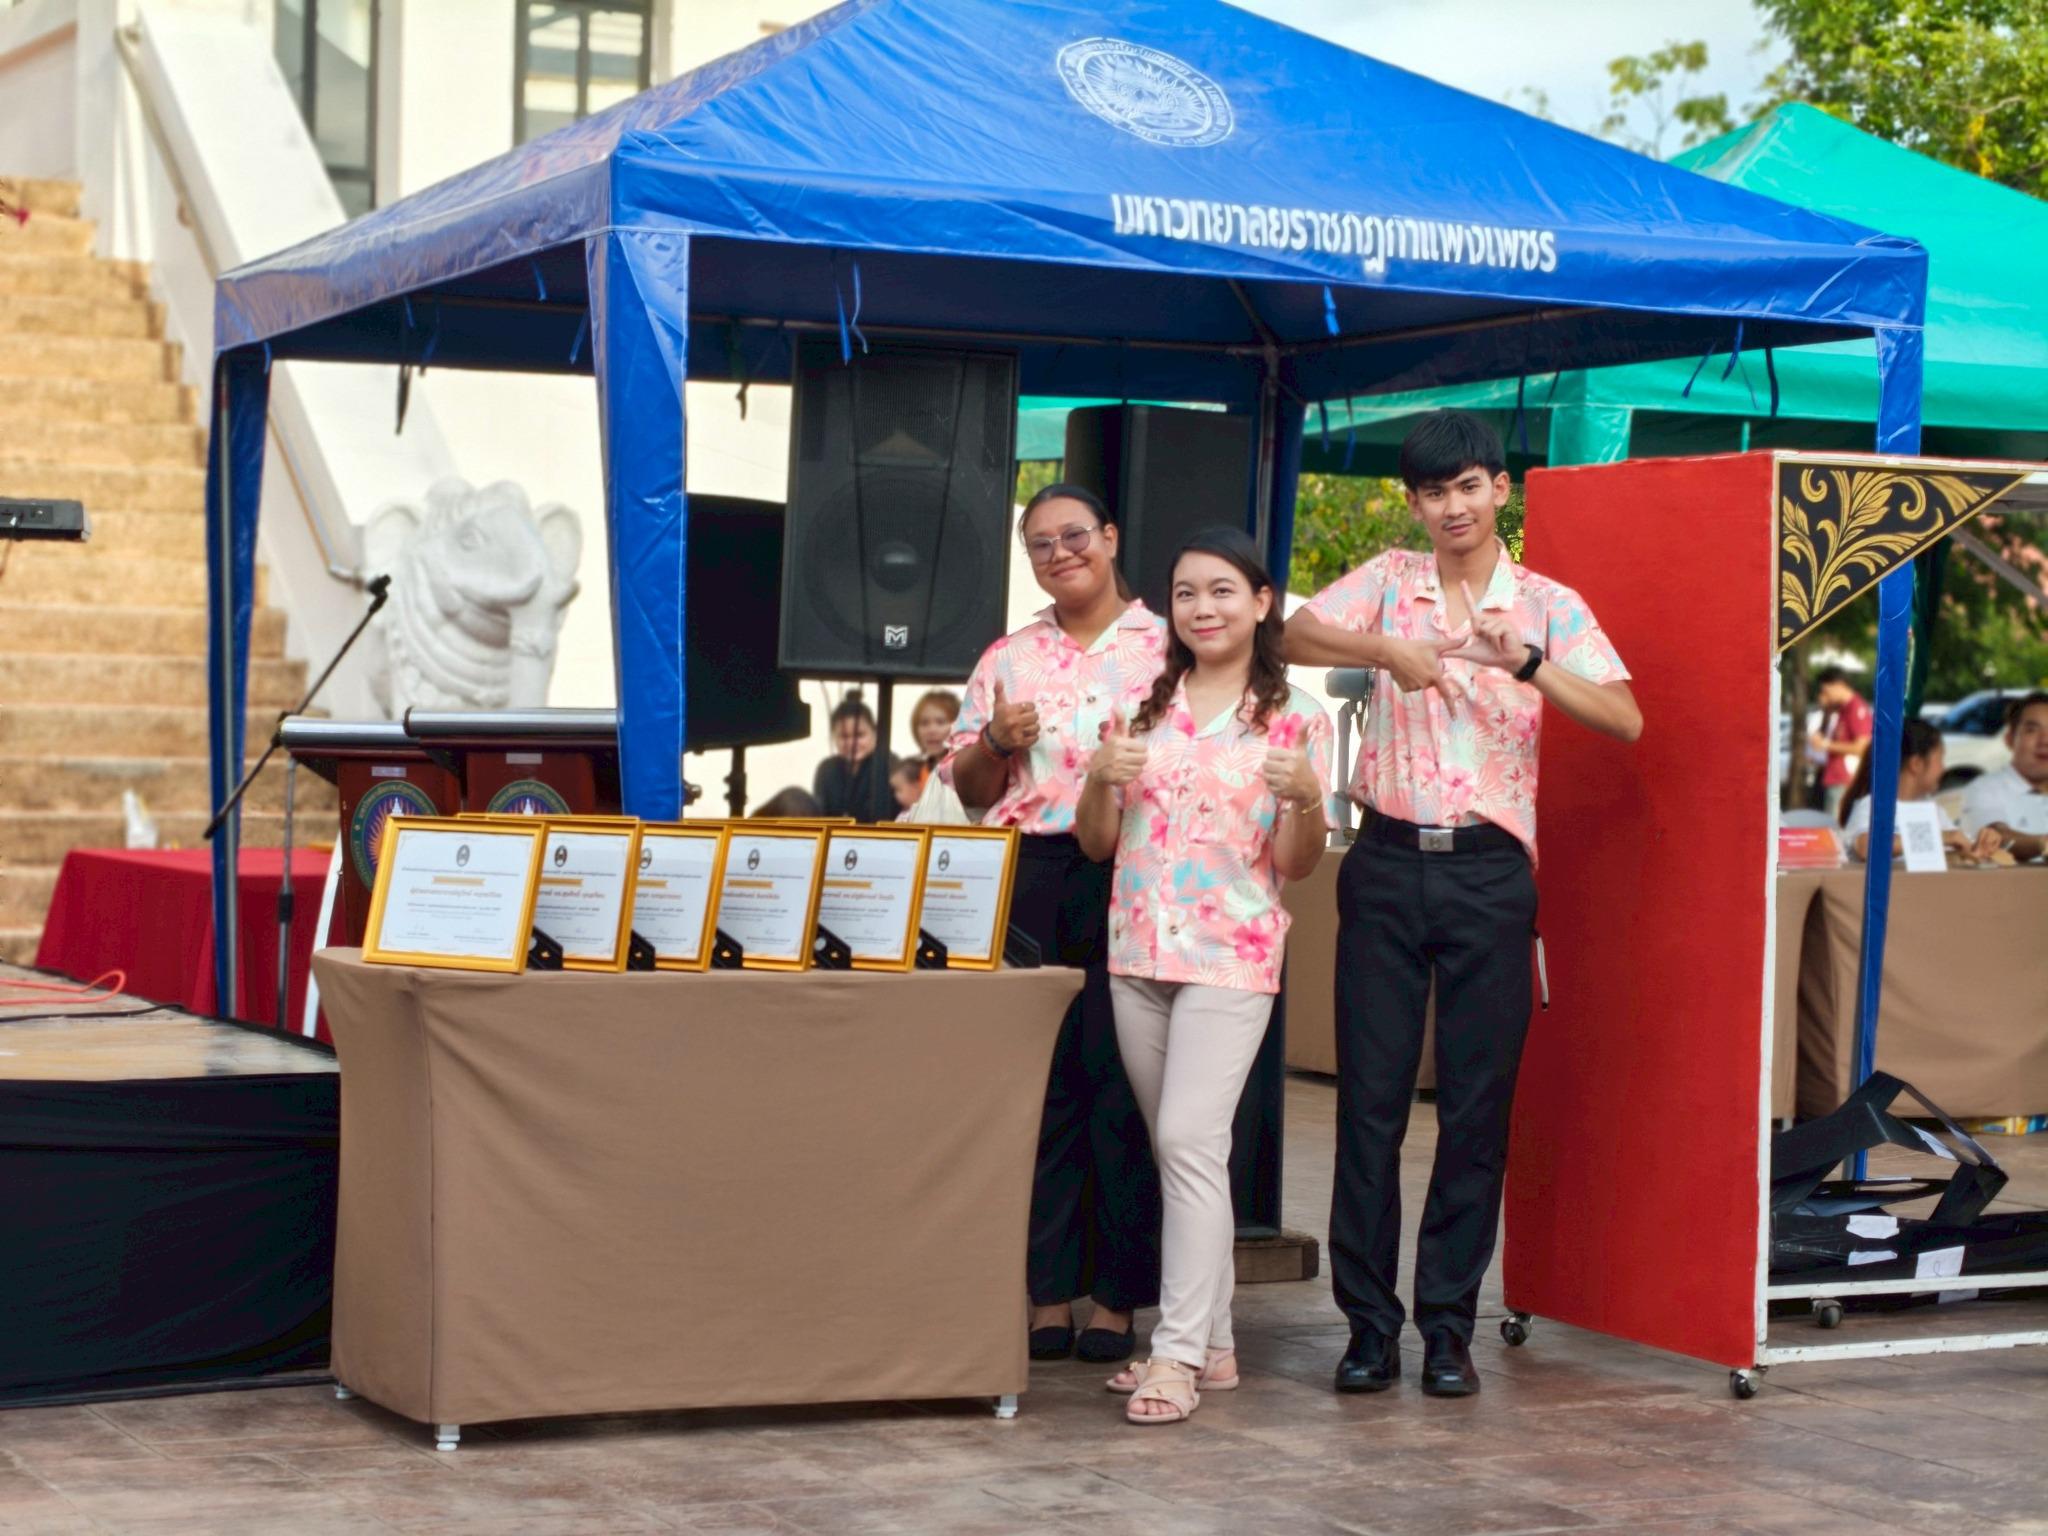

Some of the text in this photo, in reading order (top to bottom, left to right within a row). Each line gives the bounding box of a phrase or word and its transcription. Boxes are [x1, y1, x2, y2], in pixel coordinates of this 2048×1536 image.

[1112, 194, 1556, 273] มหาวทยาลยราชภฏกำแพงเพชร
